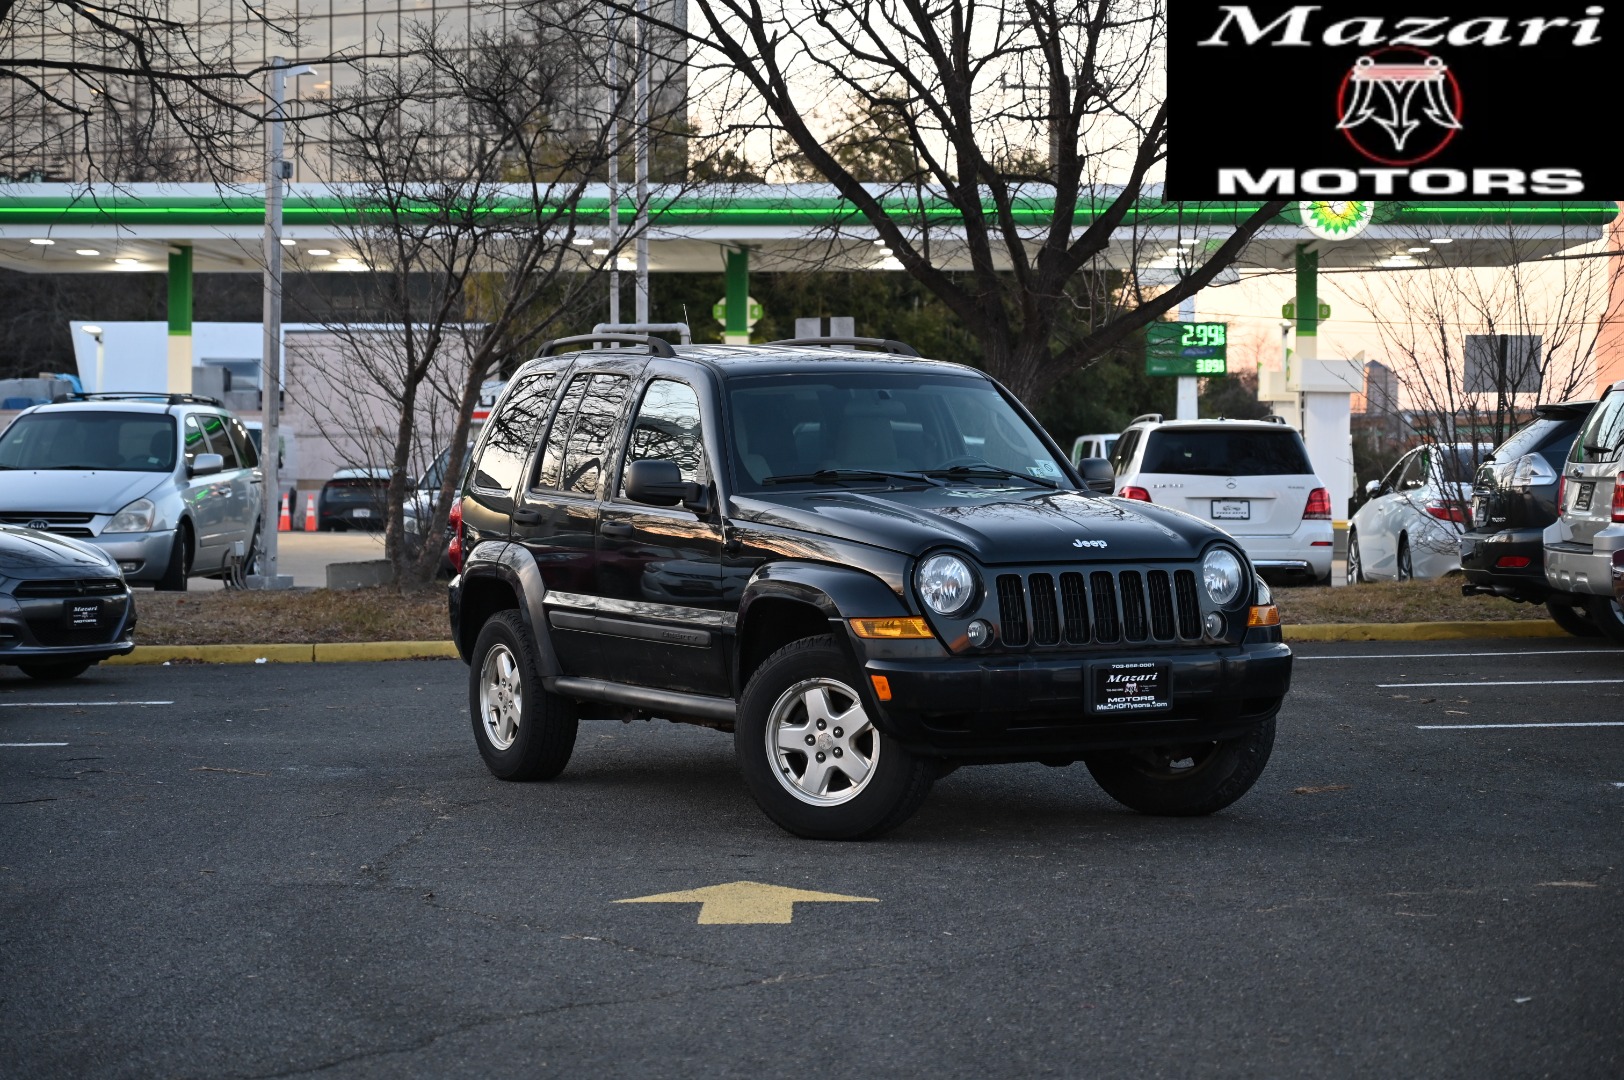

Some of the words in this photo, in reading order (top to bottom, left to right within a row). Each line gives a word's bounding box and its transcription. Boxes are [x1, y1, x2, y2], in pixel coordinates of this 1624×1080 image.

[752, 306, 759, 317] 4
[1285, 306, 1291, 316] 7
[1321, 306, 1328, 316] 8
[30, 521, 45, 529] KIA
[1072, 538, 1108, 549] Jeep
[1105, 672, 1159, 683] Mazari
[1107, 695, 1155, 703] MOTORS
